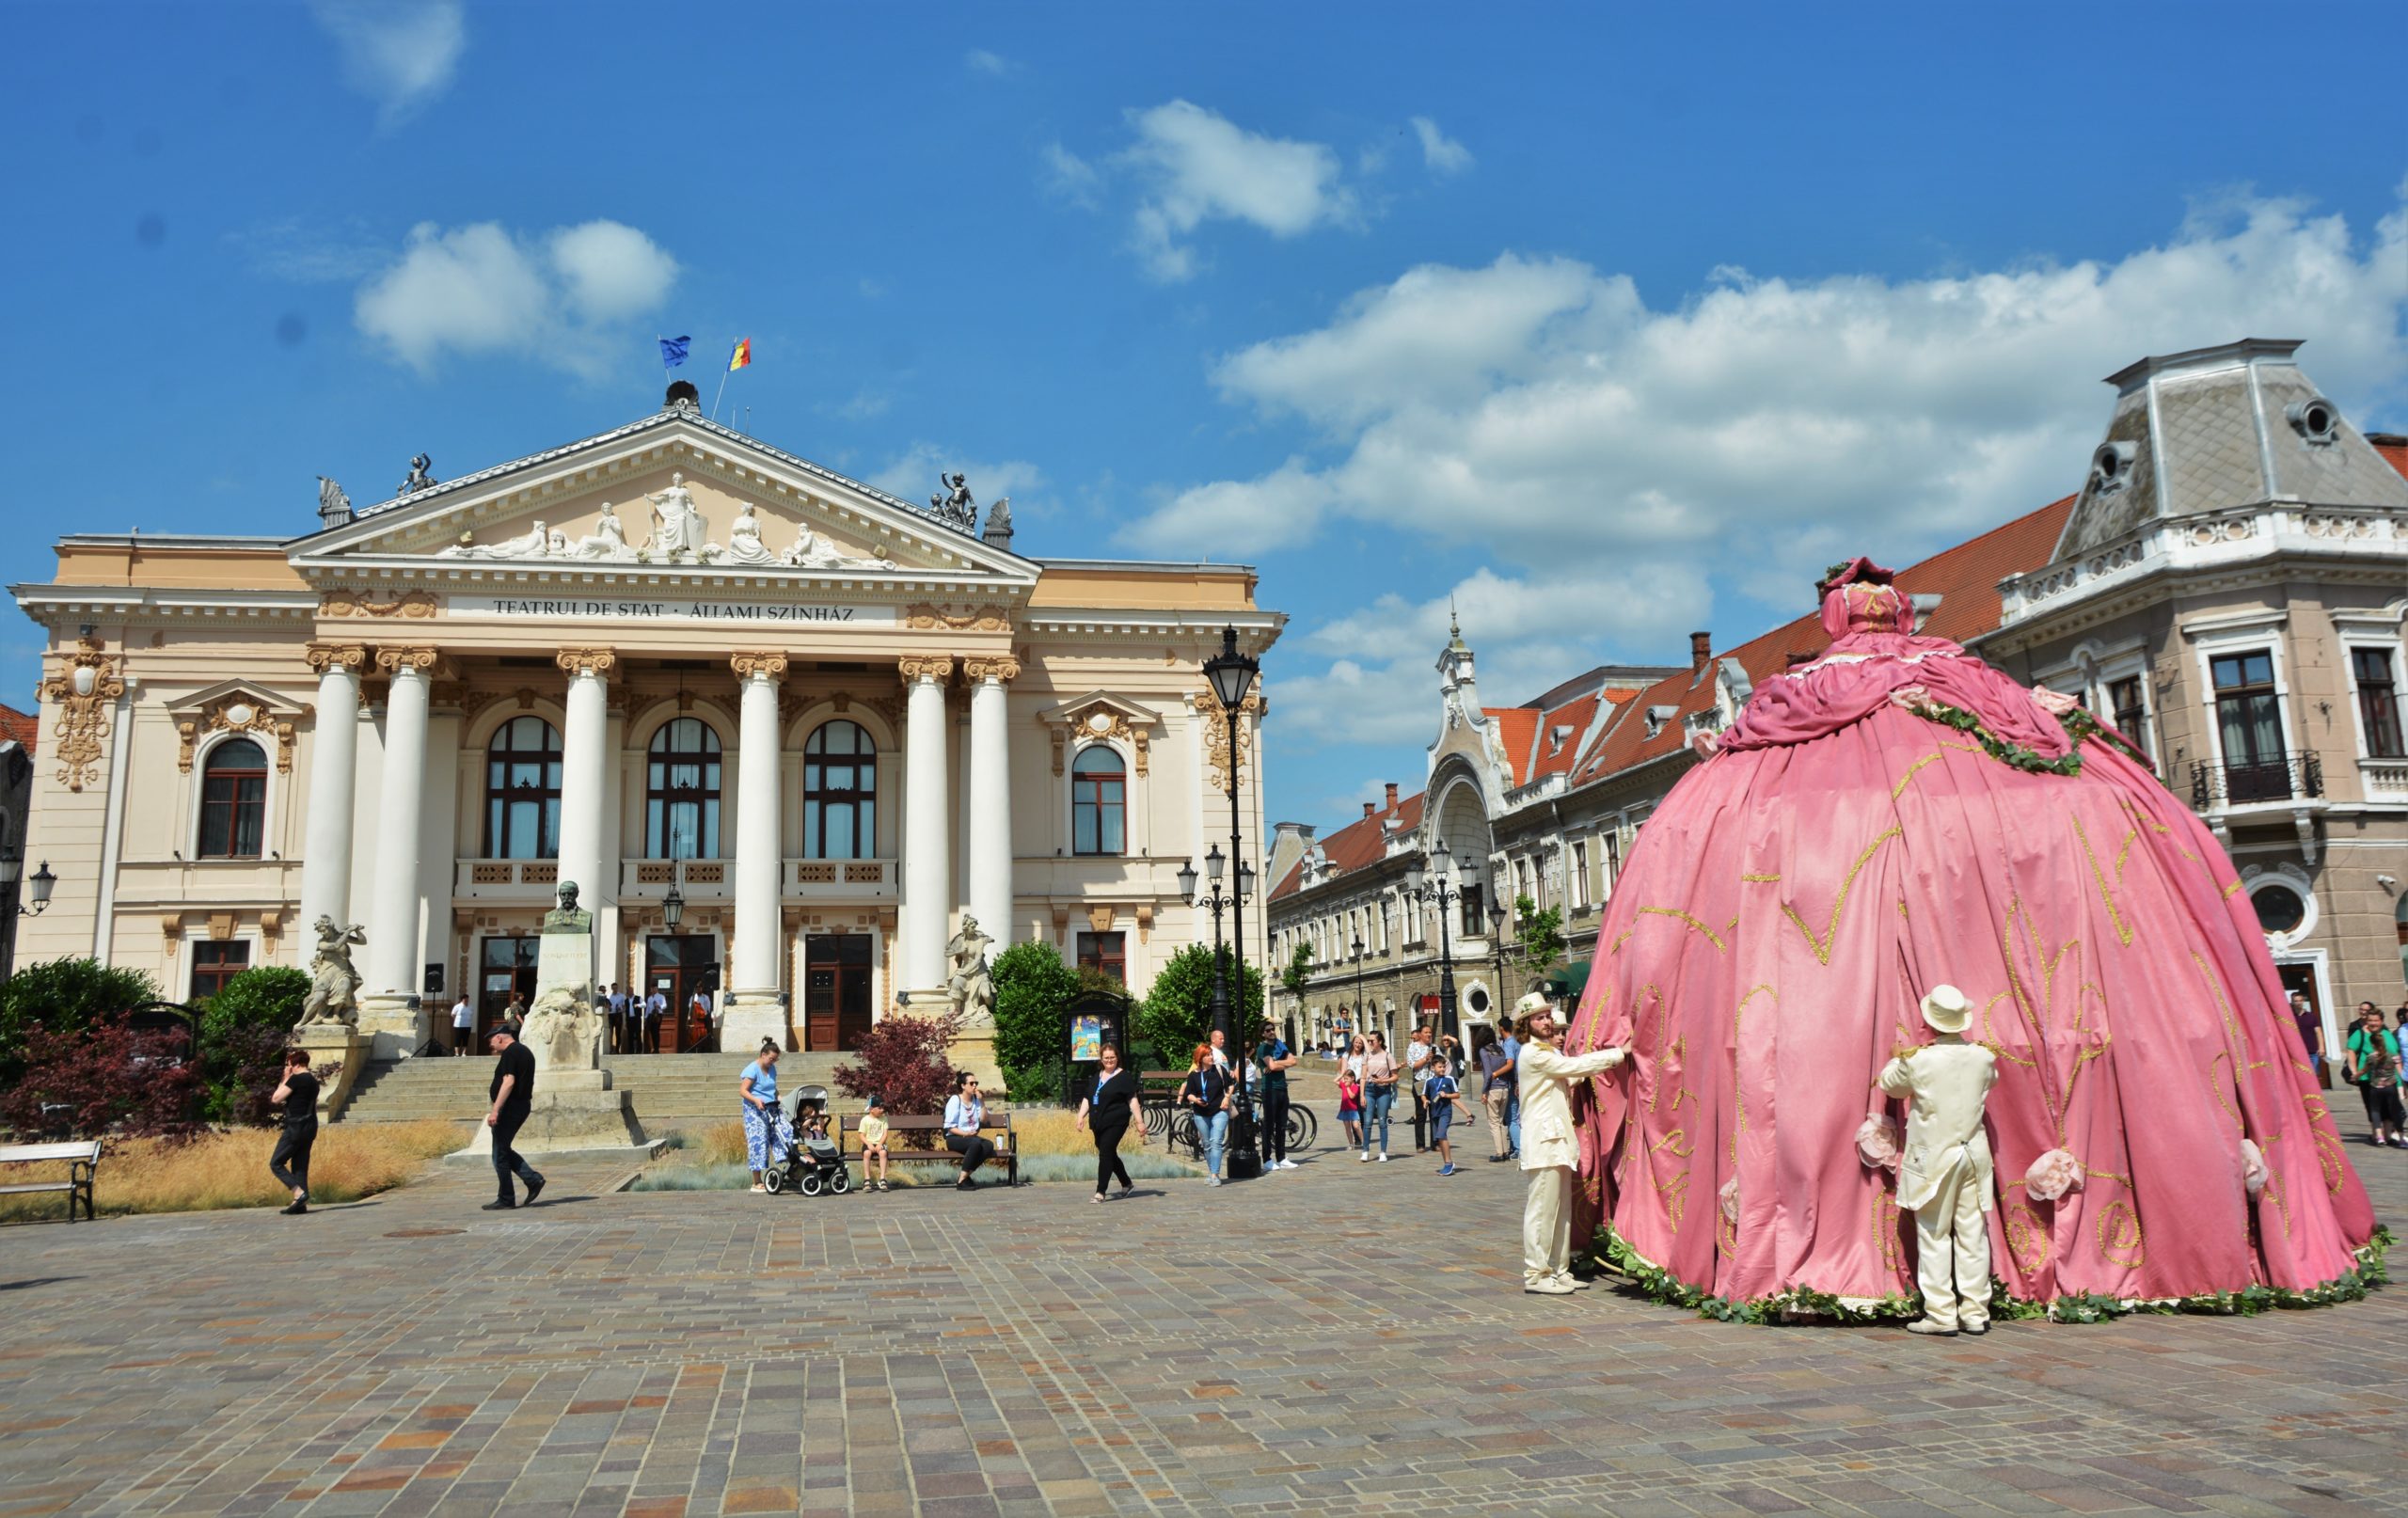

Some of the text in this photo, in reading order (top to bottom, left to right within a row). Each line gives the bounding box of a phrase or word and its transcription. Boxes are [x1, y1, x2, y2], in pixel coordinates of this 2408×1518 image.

[493, 600, 854, 622] TEATRUL DE STAT ÁLLAMI SZÍNHÁZ
